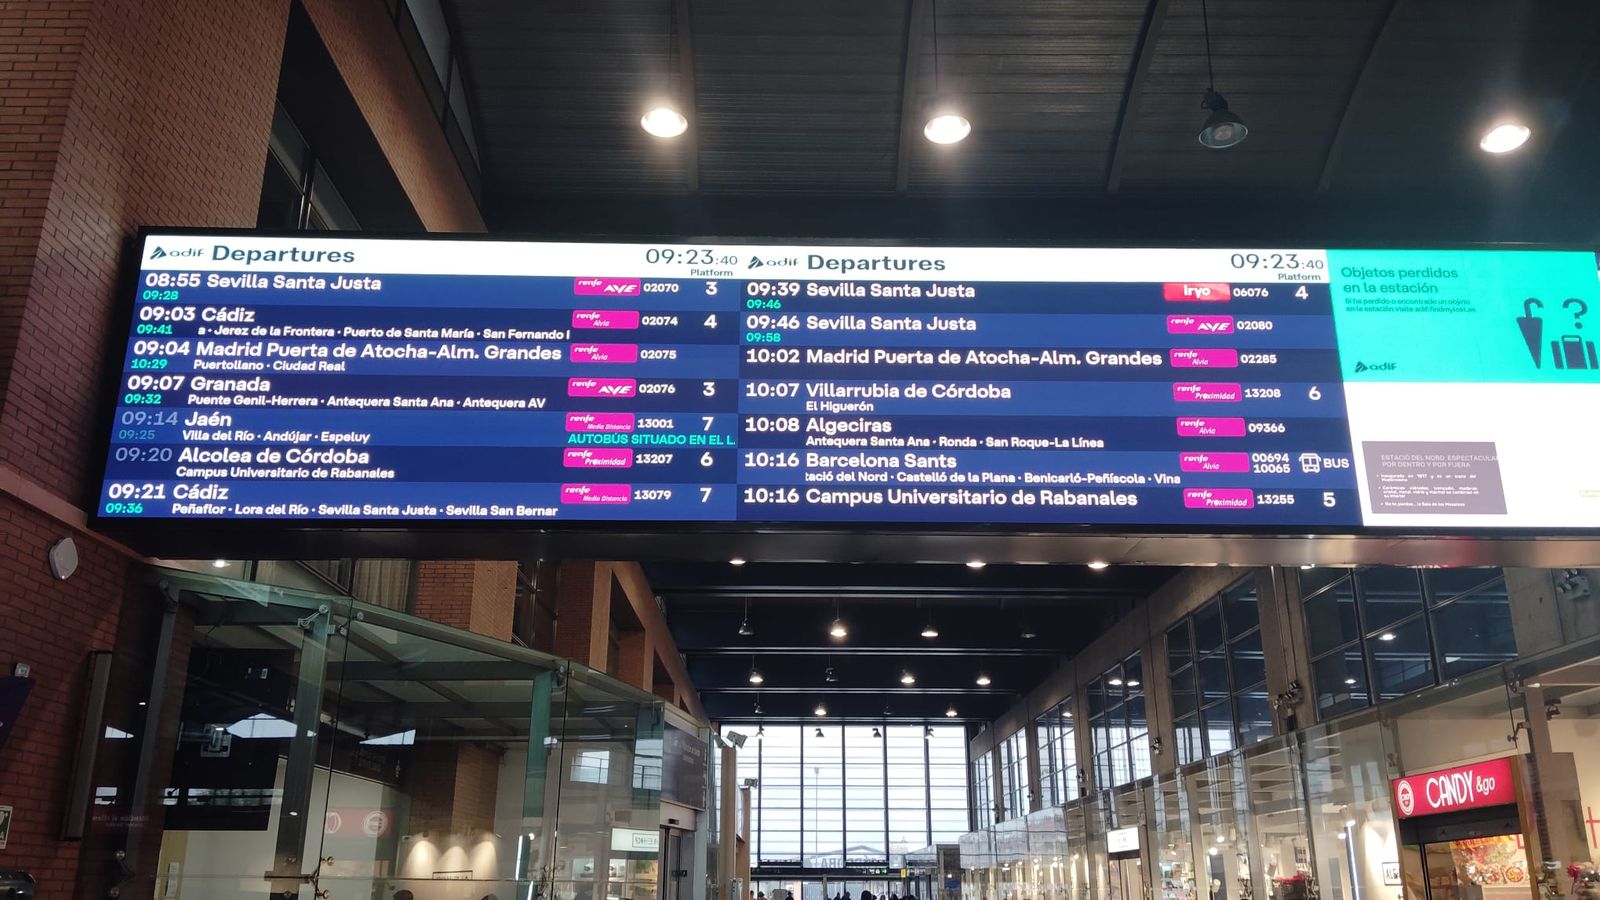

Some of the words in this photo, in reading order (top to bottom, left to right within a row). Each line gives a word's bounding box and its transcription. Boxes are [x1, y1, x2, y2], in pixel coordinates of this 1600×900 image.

[169, 247, 203, 257] adif
[211, 244, 355, 265] Departures
[807, 254, 946, 274] Departures
[145, 272, 201, 287] 08:55
[690, 268, 733, 276] Platform
[1277, 272, 1321, 280] Platform
[1340, 266, 1395, 280] Objetos
[1398, 266, 1458, 280] perdidos
[206, 272, 268, 288] Sevilla
[273, 274, 325, 289] Santa
[330, 275, 381, 290] Justa
[643, 282, 679, 292] 02070
[705, 281, 717, 295] 3
[746, 281, 800, 296] 09:39
[1343, 284, 1360, 293] en
[1363, 281, 1376, 293] la
[1379, 281, 1438, 294] estación
[142, 290, 179, 300] 09:28
[806, 281, 865, 297] Sevilla
[870, 282, 921, 297] Santa
[925, 283, 975, 297] Justa
[1232, 287, 1269, 297] 06076
[1294, 285, 1309, 299] 4
[746, 299, 781, 309] 09:46
[139, 305, 196, 321] 09:03
[201, 306, 255, 322] Cádiz
[641, 315, 678, 326] 02074
[703, 313, 717, 328] 4
[136, 323, 172, 334] 09:41
[746, 314, 800, 329] 09:46
[806, 315, 865, 330] Sevilla
[870, 315, 921, 330] Santa
[926, 316, 976, 330] Justa
[1236, 320, 1273, 330] 02080
[214, 324, 249, 335] Jerez
[251, 325, 267, 336] de
[269, 325, 281, 336] la
[283, 325, 334, 337] Frontera
[343, 326, 384, 337] Puerto
[385, 327, 401, 338] de
[404, 327, 438, 338] Santa
[441, 327, 474, 338] María
[483, 328, 505, 339] San
[508, 328, 564, 340] Fernando
[745, 332, 781, 342] 09:58
[133, 340, 190, 355] 09:04
[196, 340, 262, 357] Madrid
[266, 342, 328, 357] Puerta
[332, 342, 356, 358] de
[360, 342, 479, 359] Atocha-Alm.
[484, 344, 561, 360] Grandes
[640, 349, 677, 359] 02075
[746, 348, 800, 363] 10:02
[806, 348, 869, 364] Madrid
[874, 349, 933, 364] Puerta
[938, 349, 961, 364] de
[965, 349, 1081, 365] Atocha-Alm.
[1085, 350, 1162, 365] Grandes
[1240, 354, 1277, 363] 02285
[130, 358, 168, 369] 10:29
[193, 359, 264, 370] Puertollano
[273, 360, 316, 371] Ciudad
[318, 360, 345, 371] Real
[1368, 361, 1397, 370] adif
[127, 375, 185, 390] 09:07
[190, 375, 271, 392] Granada
[638, 383, 676, 393] 02076
[702, 381, 715, 396] 3
[745, 382, 800, 397] 10:07
[805, 382, 899, 398] Villarrubia
[904, 383, 927, 398] de
[931, 383, 1011, 398] Córdoba
[124, 393, 161, 404] 09:32
[1244, 388, 1281, 398] 13208
[1308, 385, 1321, 400] 6
[187, 393, 231, 405] Puente
[233, 394, 318, 406] Genil-Herrera
[326, 395, 390, 409] Antequera
[392, 396, 428, 407] Santa
[430, 396, 454, 407] Ana
[462, 396, 525, 410] Antequera
[527, 397, 546, 408] AV
[806, 400, 818, 411] El
[820, 400, 873, 413] Higuerón
[121, 410, 178, 425] 09:14
[184, 410, 232, 426] Jaén
[637, 418, 674, 428] 13001
[701, 416, 714, 431] 7
[745, 416, 800, 432] 10:08
[805, 416, 892, 435] Algeciras
[1247, 422, 1285, 433] 09366
[118, 429, 155, 439] 09:25
[182, 429, 209, 440] Villa
[211, 429, 232, 441] del
[234, 430, 254, 441] Río
[263, 430, 312, 444] Andújar
[321, 431, 370, 444] Espeluy
[567, 431, 628, 444] AUTOBÚS
[631, 433, 686, 445] SITUADO
[689, 434, 706, 445] EN
[708, 434, 723, 445] EL
[805, 435, 867, 448] Antequera
[870, 435, 904, 446] Santa
[906, 435, 930, 447] Ana
[939, 436, 977, 447] Ronda
[986, 436, 1008, 447] San
[1011, 436, 1069, 449] Roque-La
[1071, 436, 1104, 448] Línea
[115, 447, 172, 462] 09:20
[177, 447, 251, 463] Alcolea
[256, 447, 281, 463] de
[285, 447, 369, 464] Córdoba
[635, 453, 673, 464] 13207
[700, 451, 713, 466] 6
[744, 452, 799, 467] 10:16
[806, 452, 899, 468] Barcelona
[904, 453, 956, 468] Sants
[1251, 452, 1290, 462] 00694
[1253, 463, 1290, 473] 10065
[1323, 457, 1350, 468] BUS
[176, 465, 227, 479] Campus
[230, 466, 309, 478] Universitario
[311, 467, 328, 478] de
[330, 467, 394, 478] Rabanales
[108, 483, 166, 499] 09:21
[172, 483, 229, 500] Cádiz
[634, 489, 672, 500] 13079
[699, 487, 712, 502] 7
[743, 487, 799, 503] 10:16
[806, 488, 883, 507] Campus
[888, 488, 1007, 504] Universitario
[1011, 489, 1035, 505] de
[1040, 489, 1137, 506] Rabanales
[1256, 494, 1295, 504] 13255
[1322, 491, 1336, 507] 5
[105, 502, 143, 513] 09:36
[172, 502, 226, 514] Peñaflor
[235, 503, 263, 515] Lora
[265, 503, 286, 515] del
[288, 503, 309, 515] Río
[318, 504, 360, 515] Sevilla
[363, 504, 399, 515] Santa
[401, 504, 436, 516] Justa
[445, 504, 487, 516] Sevilla
[490, 504, 513, 516] San
[516, 504, 558, 516] Bernar
[1426, 770, 1474, 808] CANDY
[1476, 776, 1496, 796] &go
